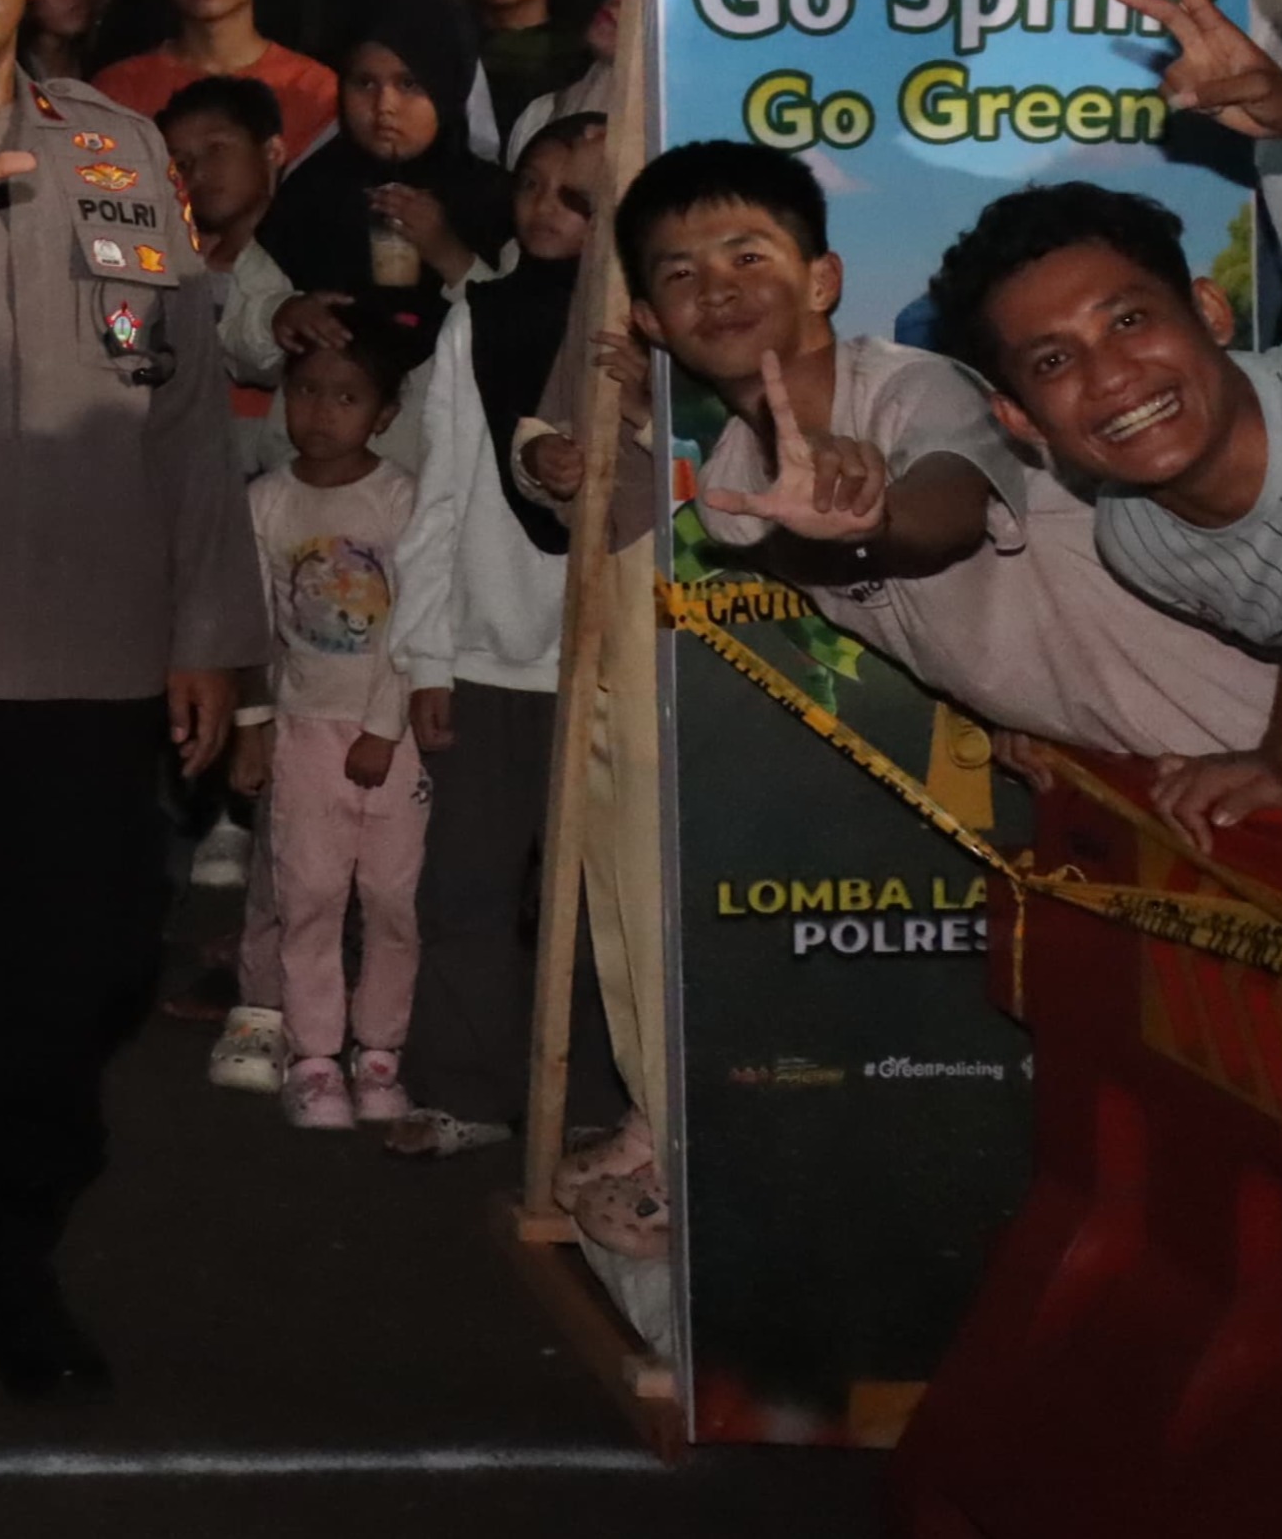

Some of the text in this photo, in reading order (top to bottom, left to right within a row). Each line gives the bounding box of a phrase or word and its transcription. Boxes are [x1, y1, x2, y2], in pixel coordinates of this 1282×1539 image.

[742, 60, 1170, 152] Go Green
[77, 198, 158, 229] POLRI
[717, 876, 913, 915] LOMBA
